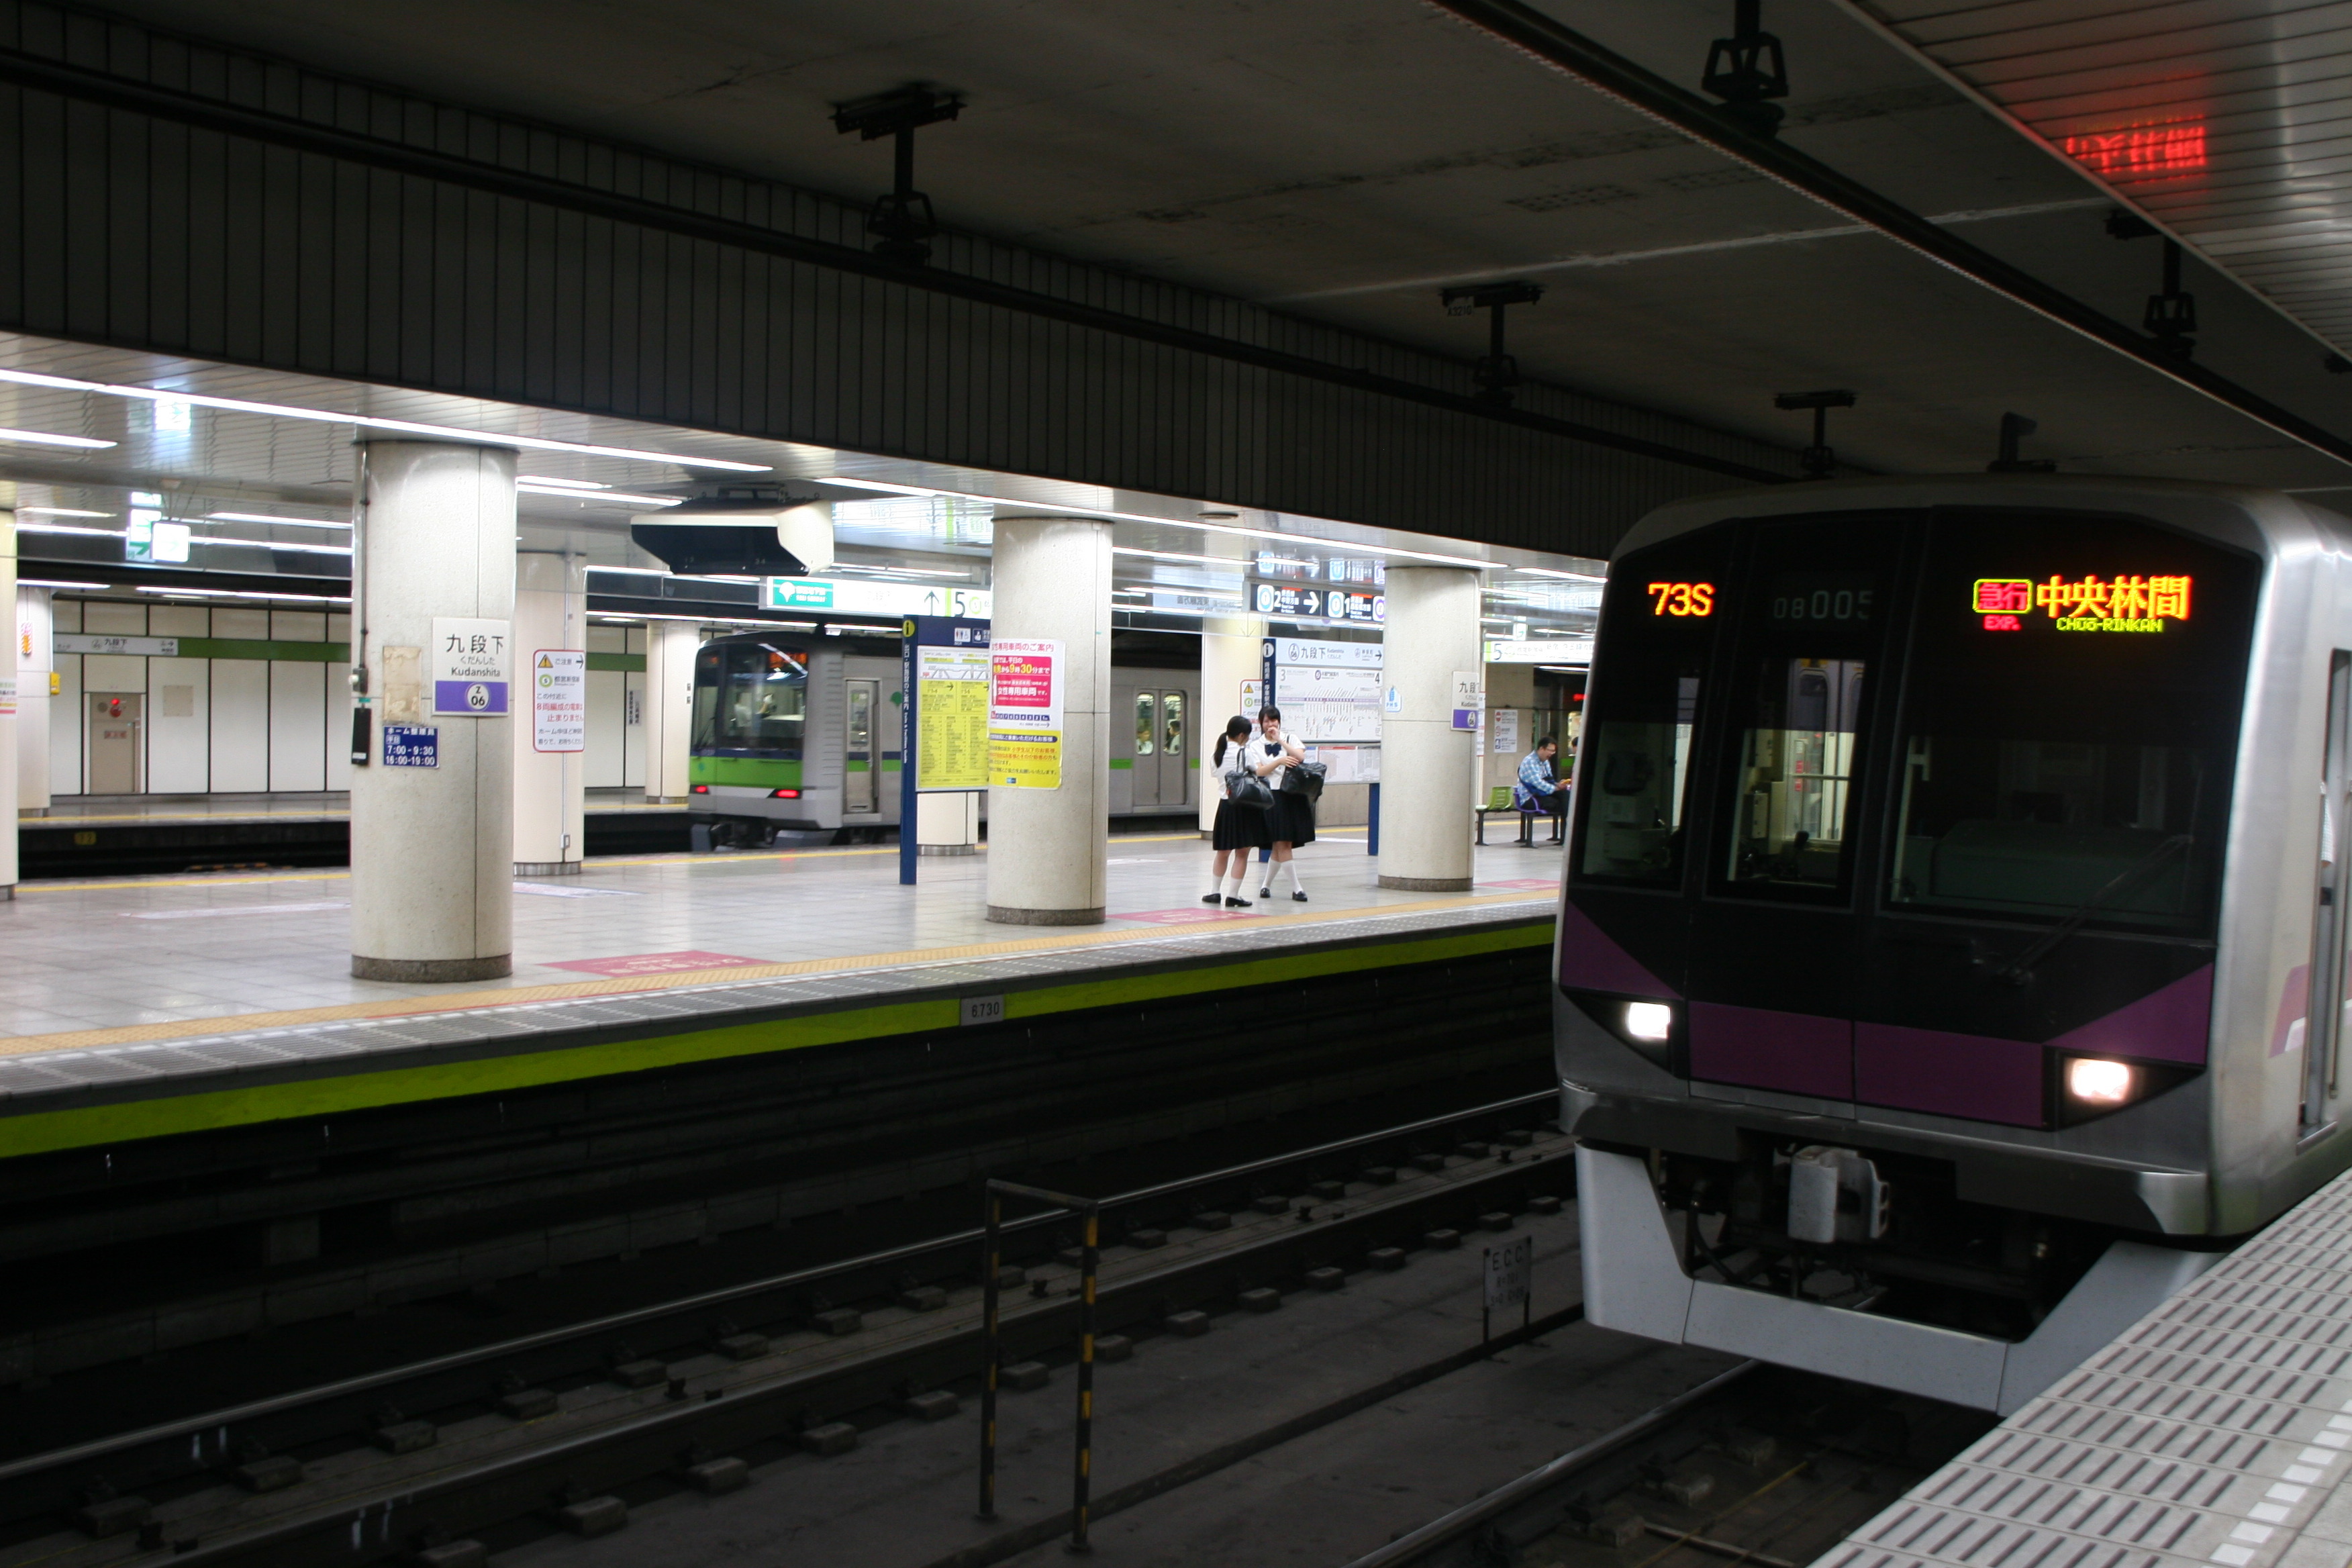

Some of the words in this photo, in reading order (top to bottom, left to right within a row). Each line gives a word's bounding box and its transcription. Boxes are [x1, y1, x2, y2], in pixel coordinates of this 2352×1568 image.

[1275, 591, 1281, 607] 2
[1648, 582, 1716, 616] 73S
[1978, 582, 2028, 611] 急行
[2037, 575, 2192, 621] 中央林間
[955, 592, 965, 618] 5
[1344, 597, 1350, 614] 1
[1983, 615, 2022, 631] EXP.
[446, 634, 504, 654] 九段下
[1493, 644, 1502, 660] 5
[460, 656, 495, 665] くだんした
[1301, 647, 1326, 659] 九段下
[451, 667, 501, 677] Kudanshita
[1281, 669, 1286, 681] 3
[1375, 672, 1380, 684] 4
[476, 686, 481, 694] Z
[1459, 681, 1479, 693] 九段
[471, 695, 485, 705] 06
[1492, 1245, 1522, 1271] ECC
